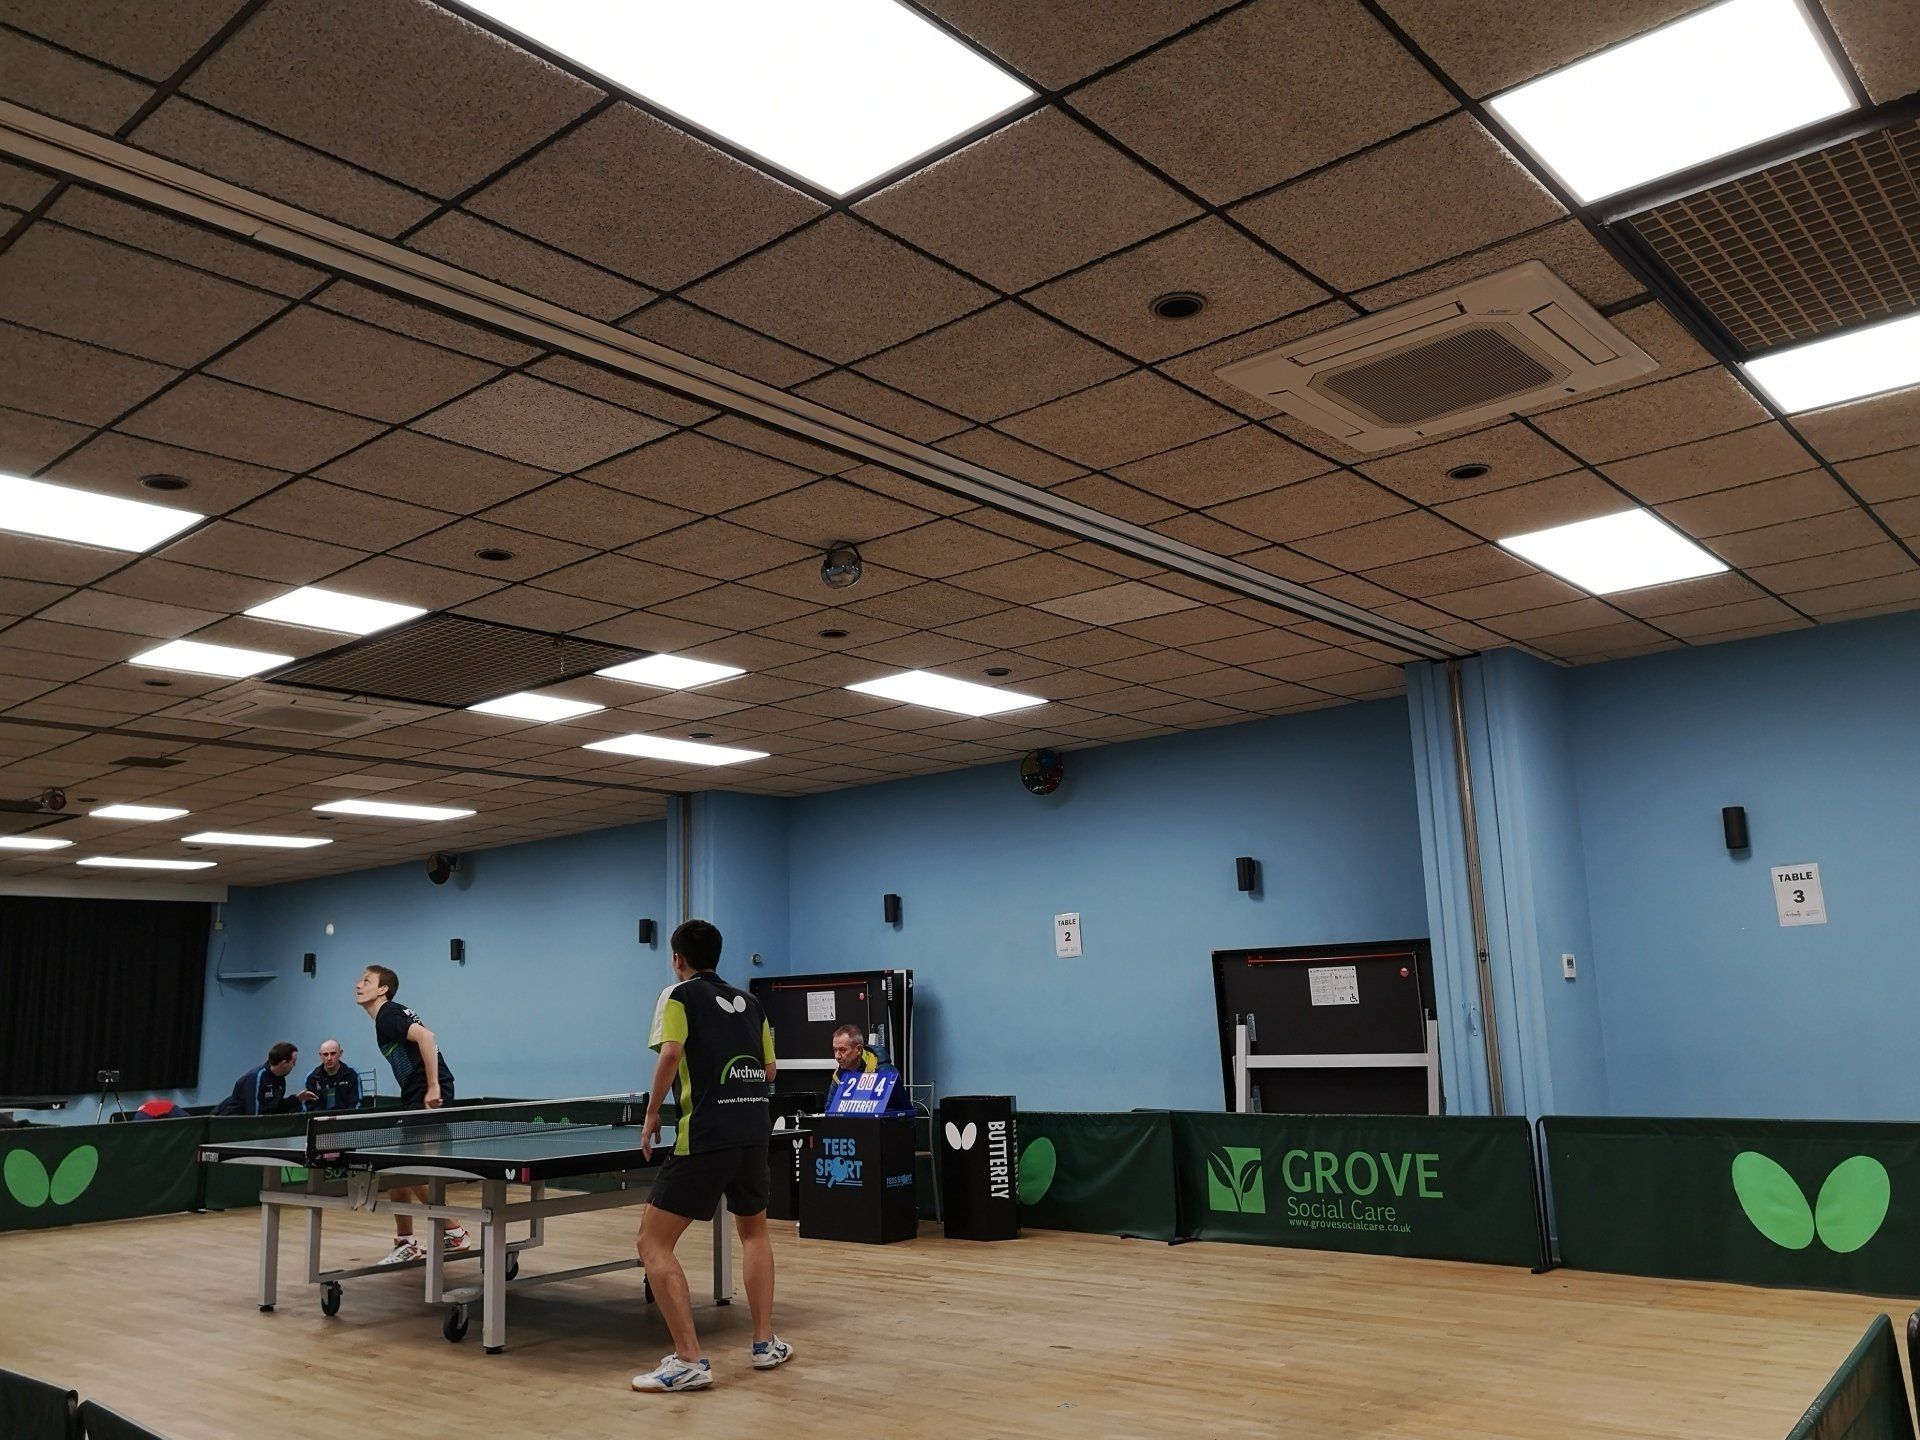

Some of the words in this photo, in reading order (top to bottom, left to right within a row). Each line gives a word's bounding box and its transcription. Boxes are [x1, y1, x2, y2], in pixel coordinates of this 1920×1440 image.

[1777, 871, 1813, 883] TABLE
[1792, 889, 1806, 904] 3
[1057, 918, 1077, 927] TABLE
[1064, 931, 1072, 942] 2
[729, 1065, 767, 1082] Archway
[843, 1077, 857, 1097] 2
[874, 1077, 887, 1097] 4
[837, 1100, 879, 1113] BUTTERFLY
[822, 1138, 856, 1156] TEES
[987, 1120, 1010, 1199] BUTTERFLY
[815, 1157, 863, 1180] SPORT
[1282, 1149, 1443, 1198] GROVE
[1287, 1196, 1345, 1219] Social
[1351, 1200, 1396, 1222] Care
[1289, 1218, 1412, 1233] www.grovesocialcare.co.uk
